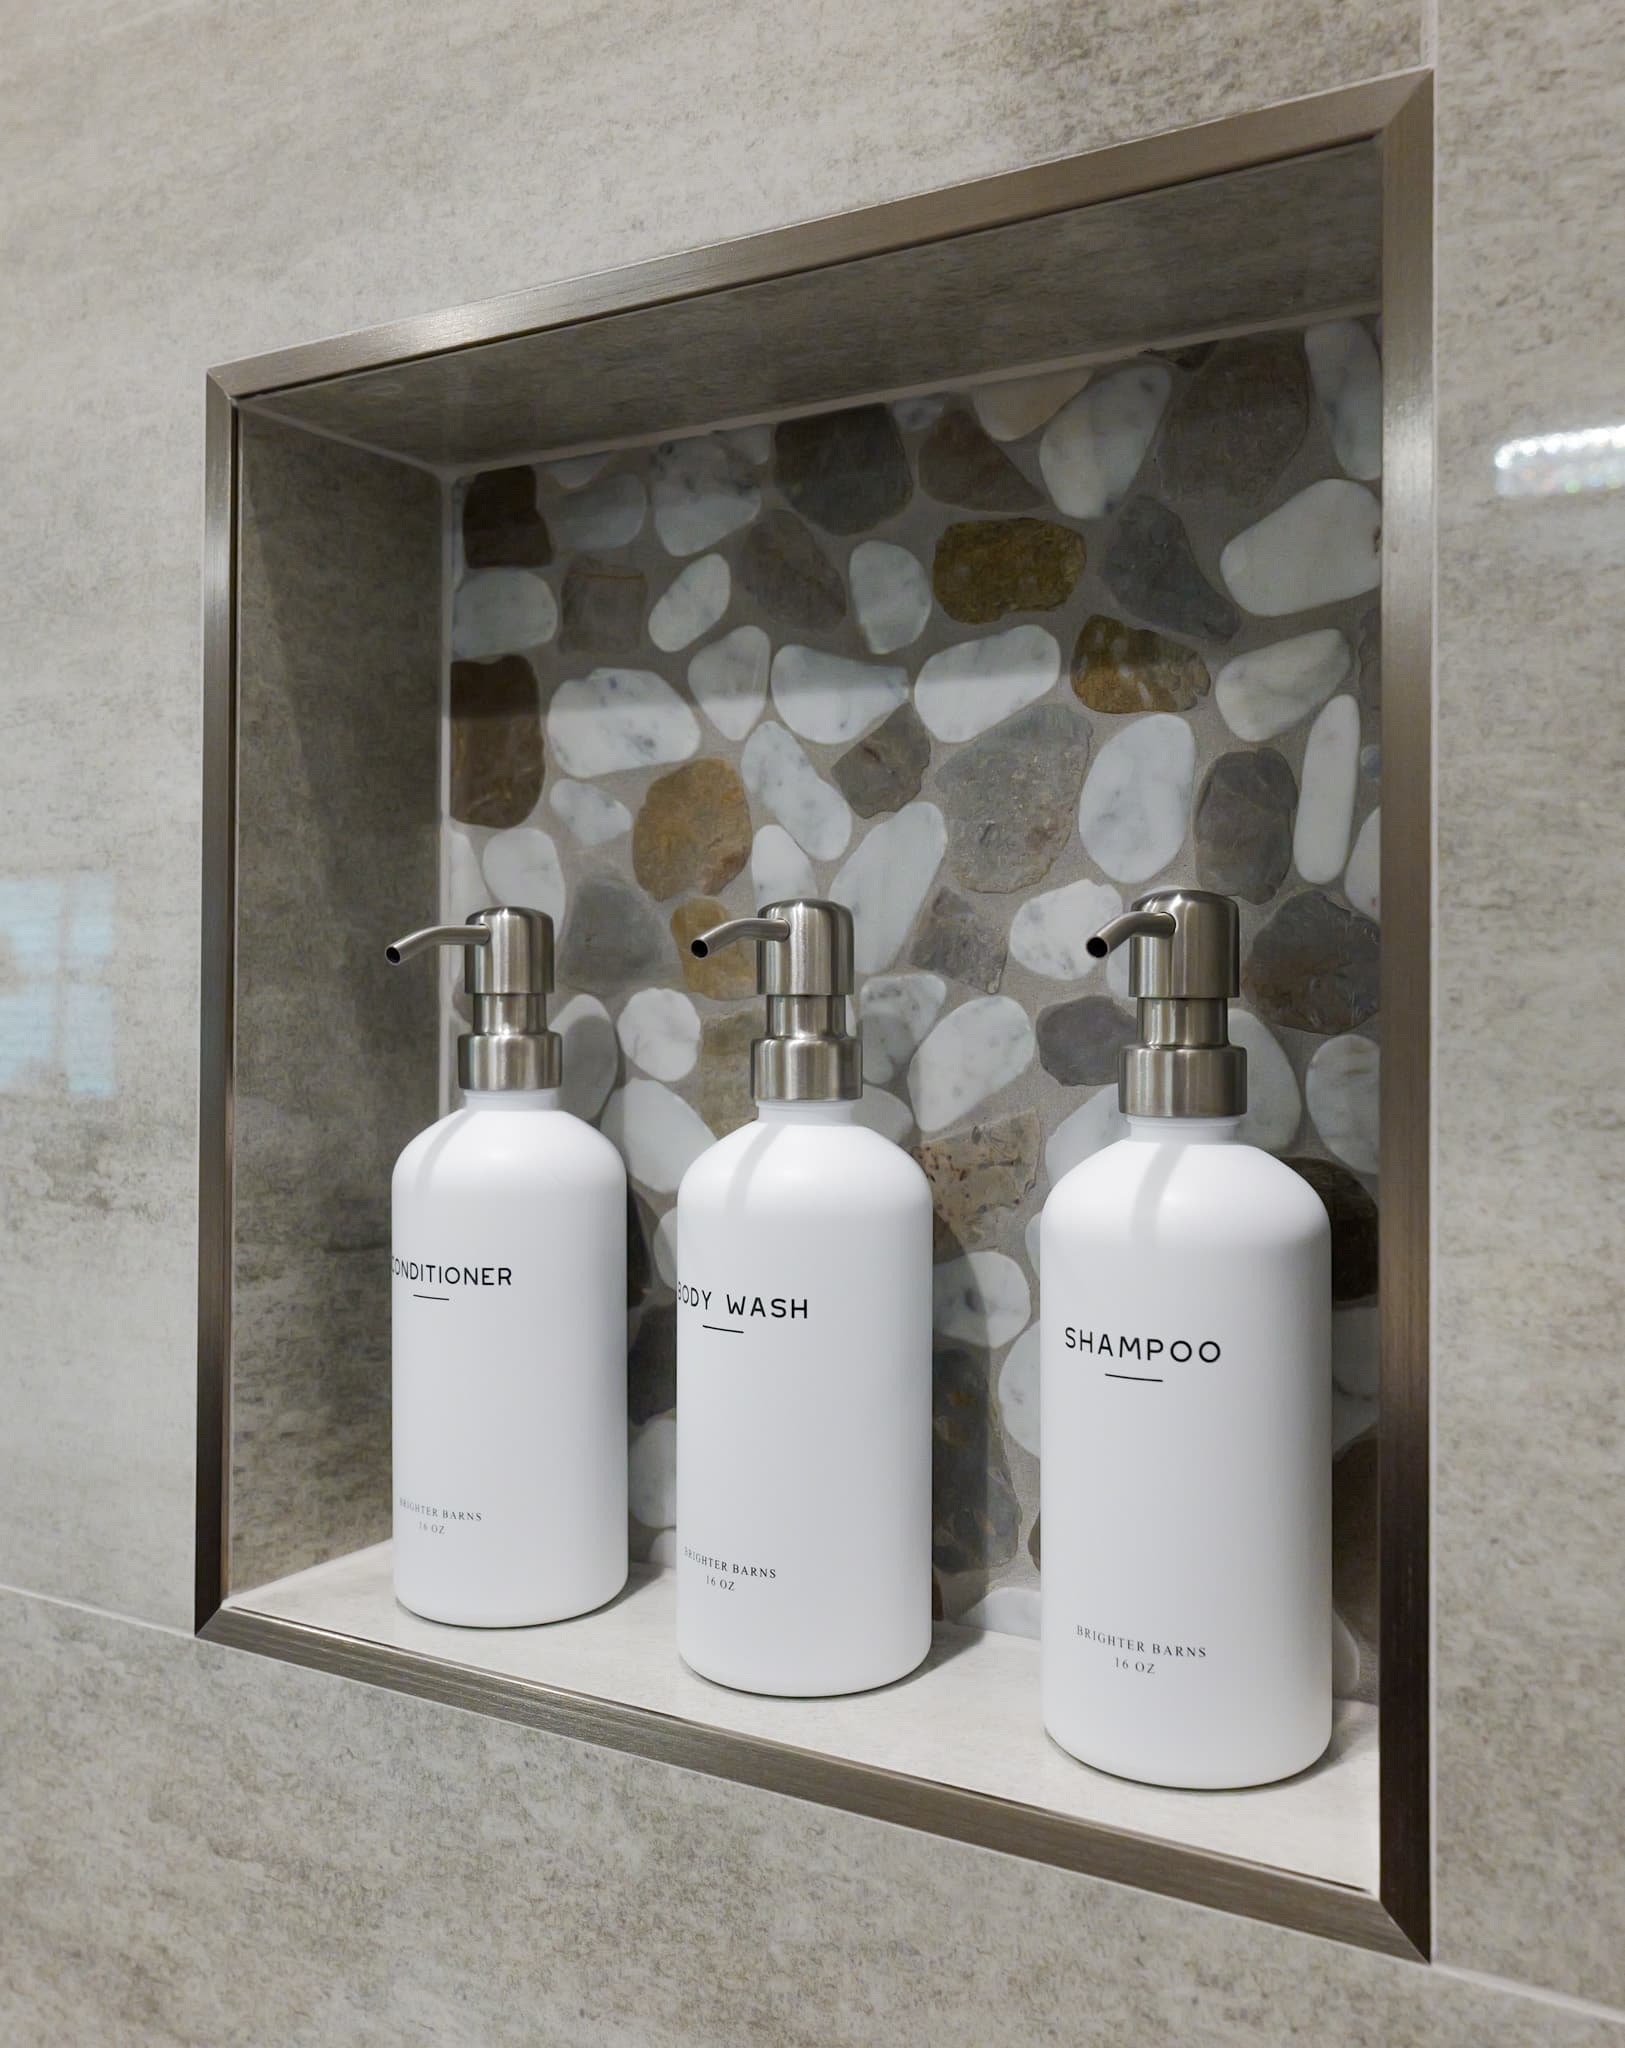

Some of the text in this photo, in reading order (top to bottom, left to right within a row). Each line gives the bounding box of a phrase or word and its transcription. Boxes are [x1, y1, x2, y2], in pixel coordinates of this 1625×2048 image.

[392, 1256, 513, 1287] ONDITIONER
[726, 1293, 808, 1319] WASH
[1064, 1326, 1222, 1364] SHAMPOO
[442, 1509, 482, 1521] BARNS
[418, 1520, 446, 1535] 16 OZ
[732, 1563, 777, 1579] BARNS
[705, 1575, 735, 1592] 16 OZ
[1076, 1624, 1207, 1658] BRIGHTER BARNS
[1114, 1656, 1156, 1674] 16 OZ
